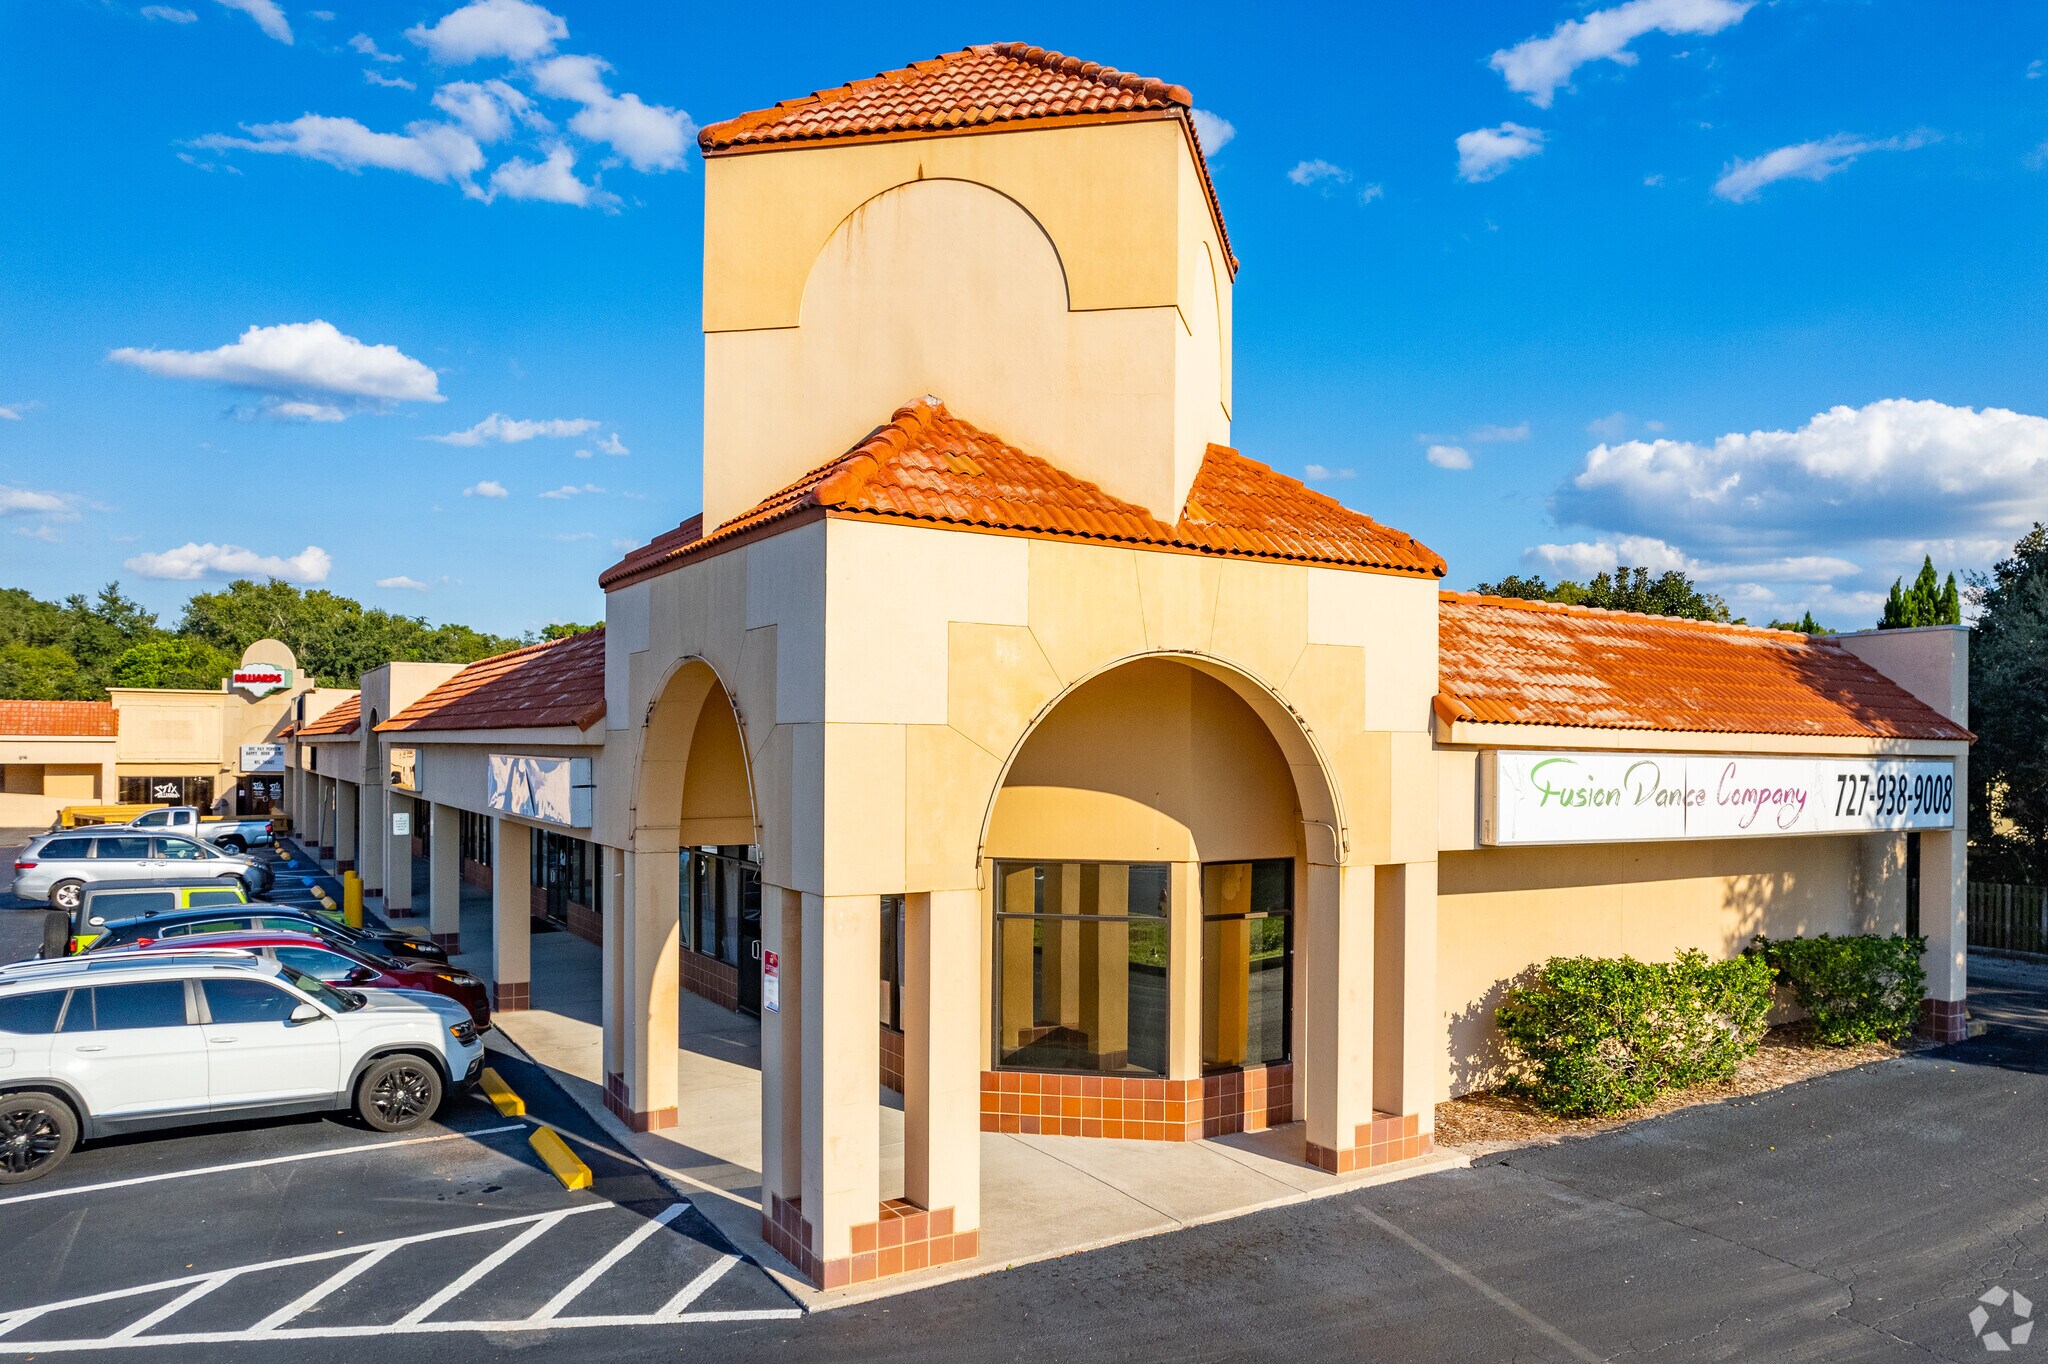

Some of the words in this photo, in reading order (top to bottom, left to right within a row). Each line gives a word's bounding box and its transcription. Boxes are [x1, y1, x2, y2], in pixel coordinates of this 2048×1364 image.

[234, 673, 282, 683] BILLIARDS
[1530, 757, 1622, 807] Fusion
[1624, 759, 1707, 807] Dance
[1717, 761, 1808, 829] Company
[1834, 773, 1954, 817] 727-938-9008
